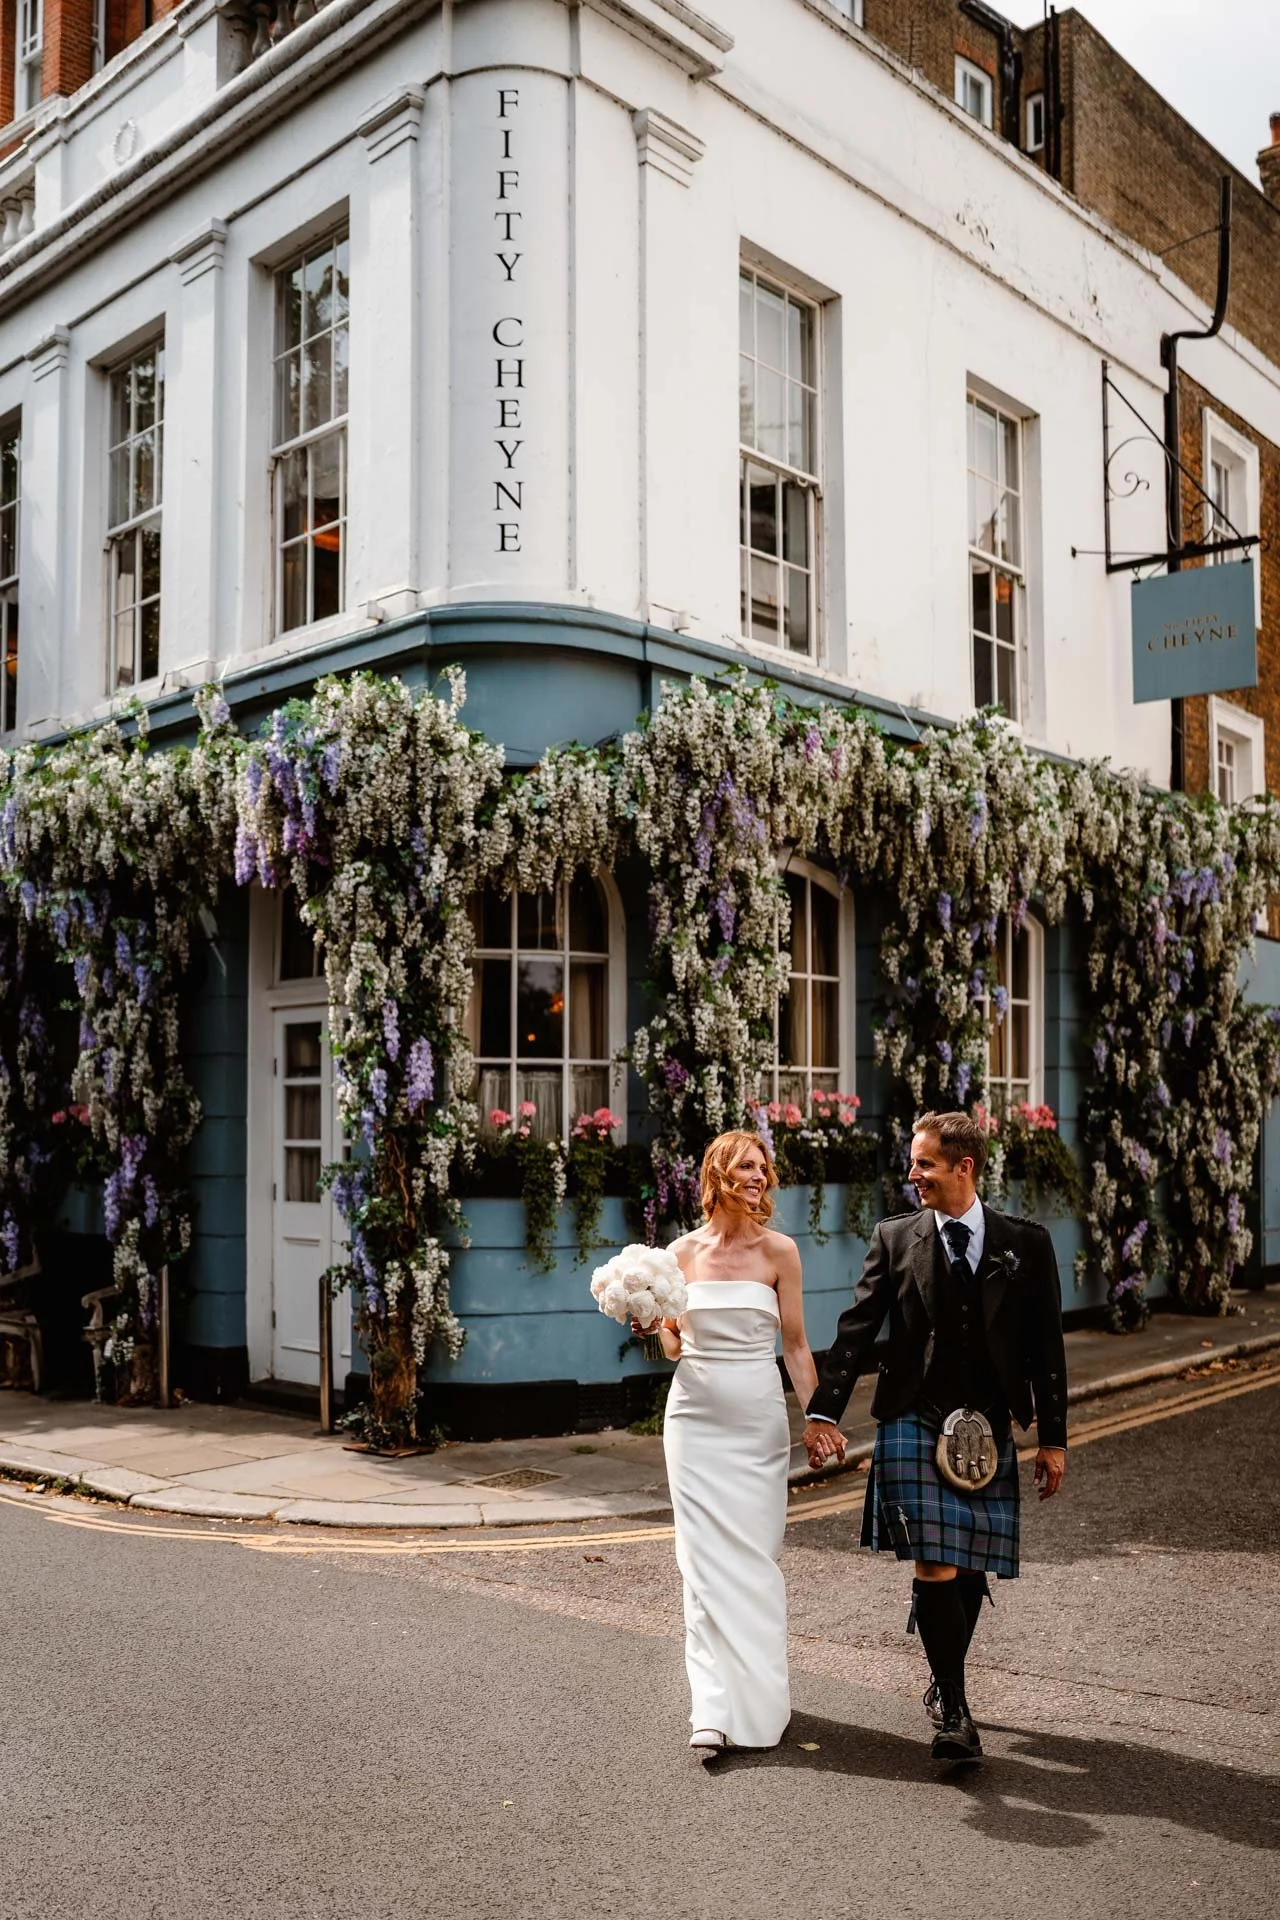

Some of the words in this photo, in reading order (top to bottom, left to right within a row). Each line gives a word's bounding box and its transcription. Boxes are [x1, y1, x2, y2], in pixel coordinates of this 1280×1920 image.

[494, 89, 523, 282] FIFTY
[492, 317, 525, 553] CHEYNE
[1146, 623, 1237, 652] CHEYNE
